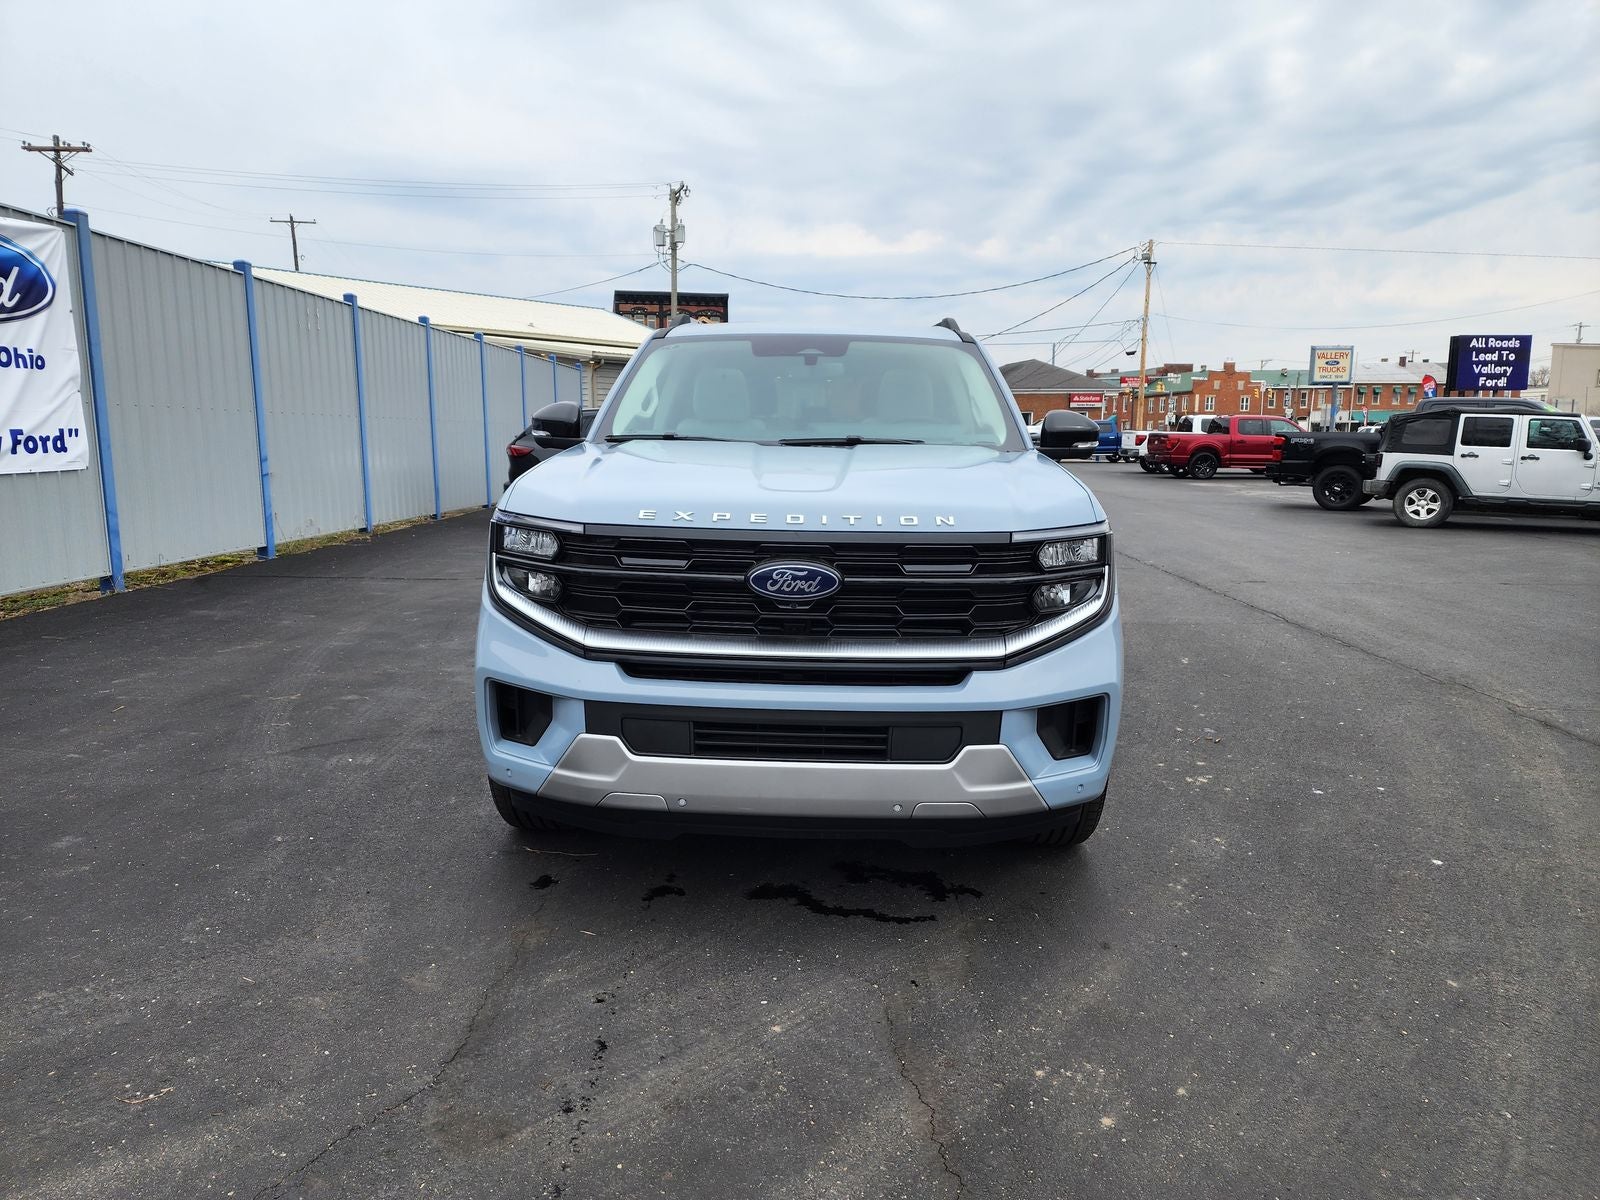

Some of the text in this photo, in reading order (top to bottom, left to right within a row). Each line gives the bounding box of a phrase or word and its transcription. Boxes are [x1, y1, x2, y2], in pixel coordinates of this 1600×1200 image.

[1469, 337, 1521, 348] All Roads
[0, 346, 46, 370] Ohio
[1316, 351, 1350, 360] VALLERY
[1472, 350, 1516, 361] Lead To
[1472, 363, 1513, 377] Vallery
[1478, 376, 1507, 387] Ford!
[9, 428, 79, 455] Ford"
[638, 509, 955, 526] EXPEDITION
[766, 568, 821, 594] Ford
